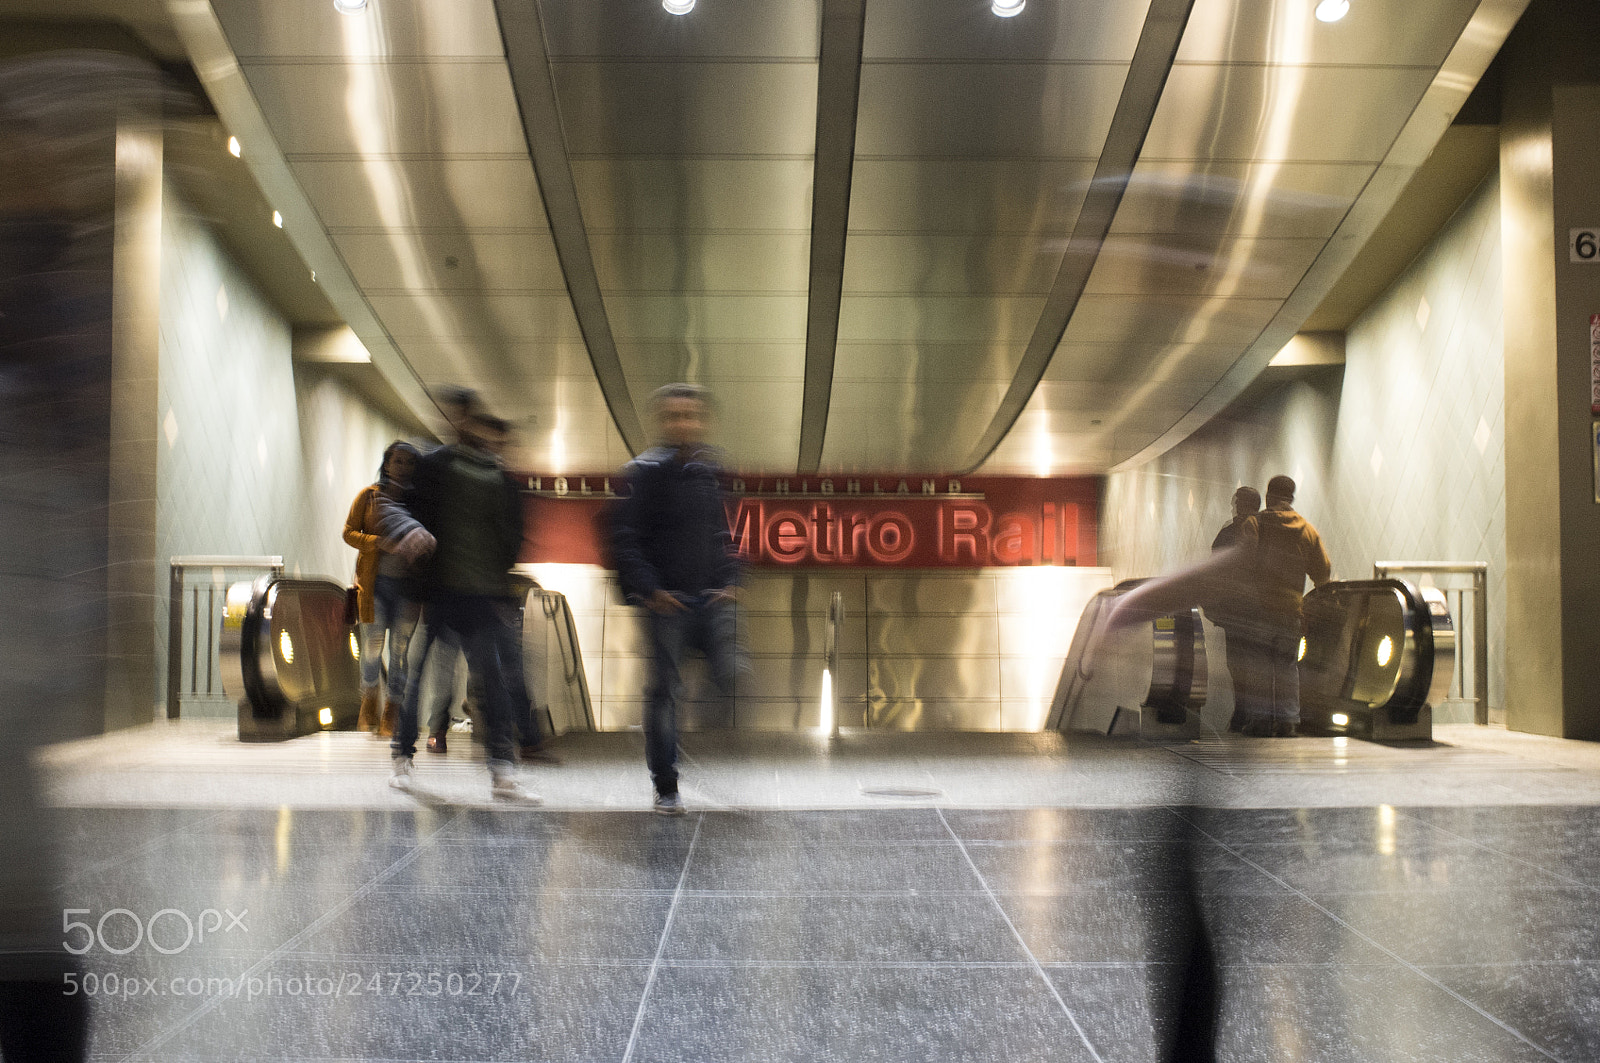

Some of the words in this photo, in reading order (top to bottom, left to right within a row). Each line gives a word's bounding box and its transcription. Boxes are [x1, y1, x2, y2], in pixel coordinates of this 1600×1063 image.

[1575, 231, 1600, 259] 6
[527, 476, 964, 496] HOLLD/HIGHLAND
[721, 501, 914, 562] Metro
[938, 501, 1079, 562] Rail
